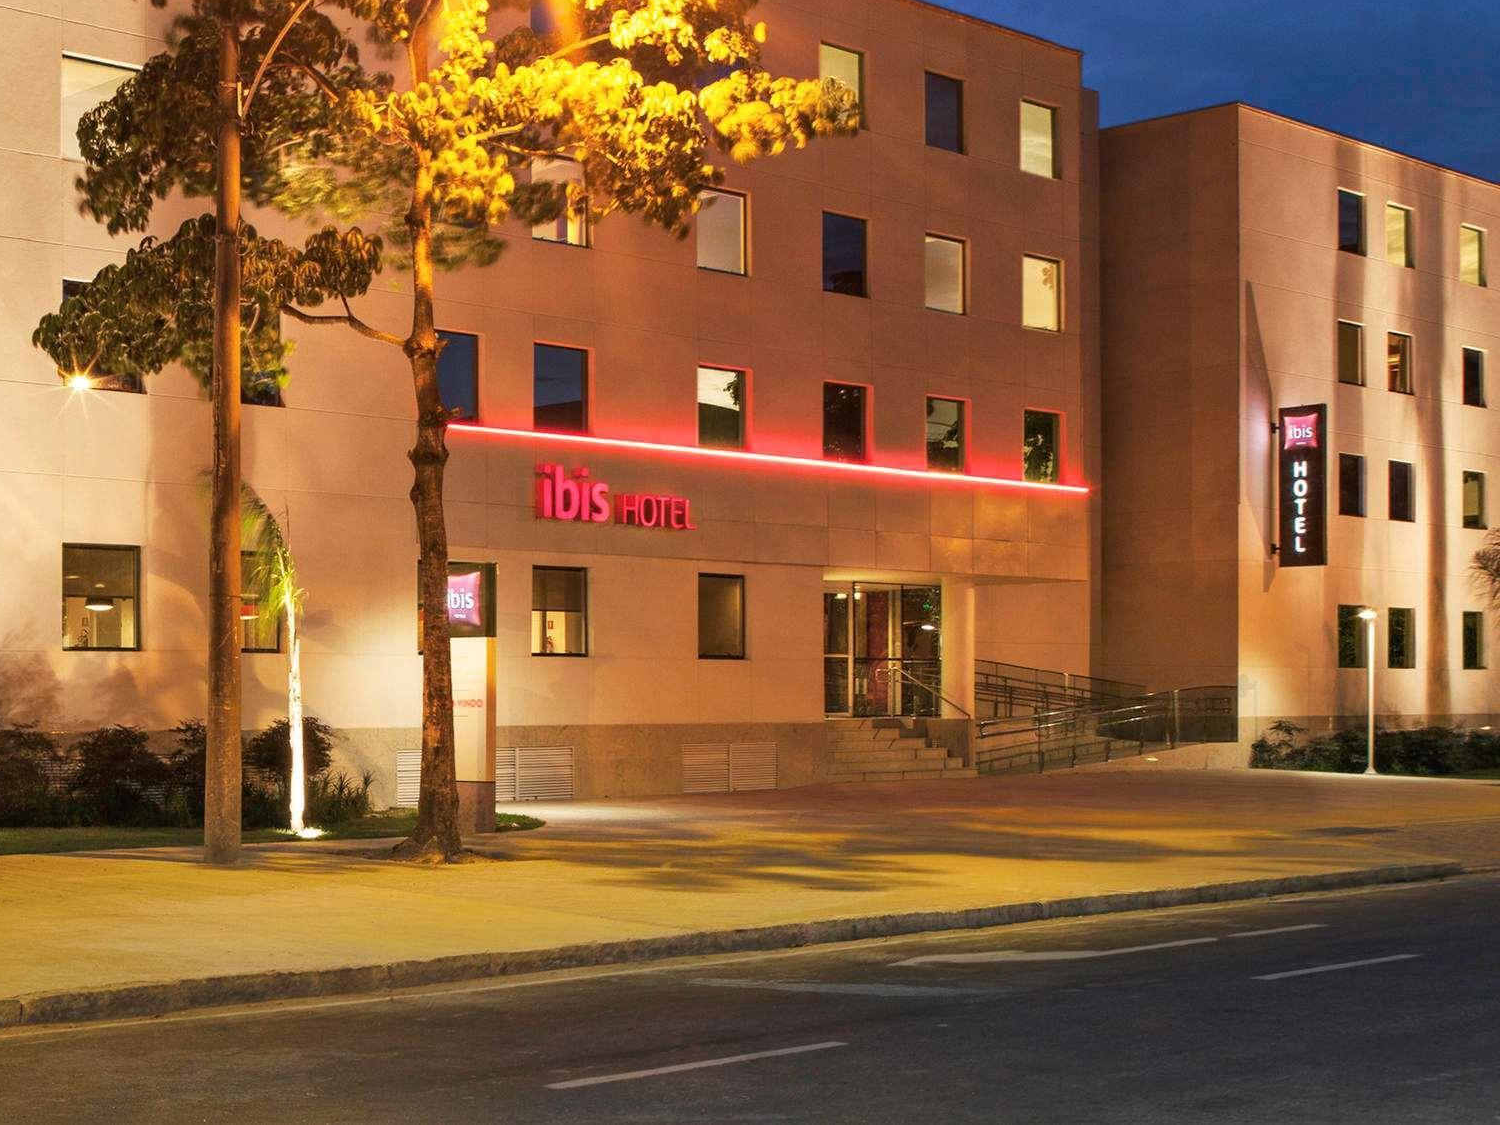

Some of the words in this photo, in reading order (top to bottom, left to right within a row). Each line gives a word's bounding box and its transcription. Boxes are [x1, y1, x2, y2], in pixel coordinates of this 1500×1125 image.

[1288, 424, 1313, 439] ibis
[536, 463, 610, 523] ibis
[616, 494, 697, 530] HOTEL
[1293, 460, 1308, 553] HOTEL
